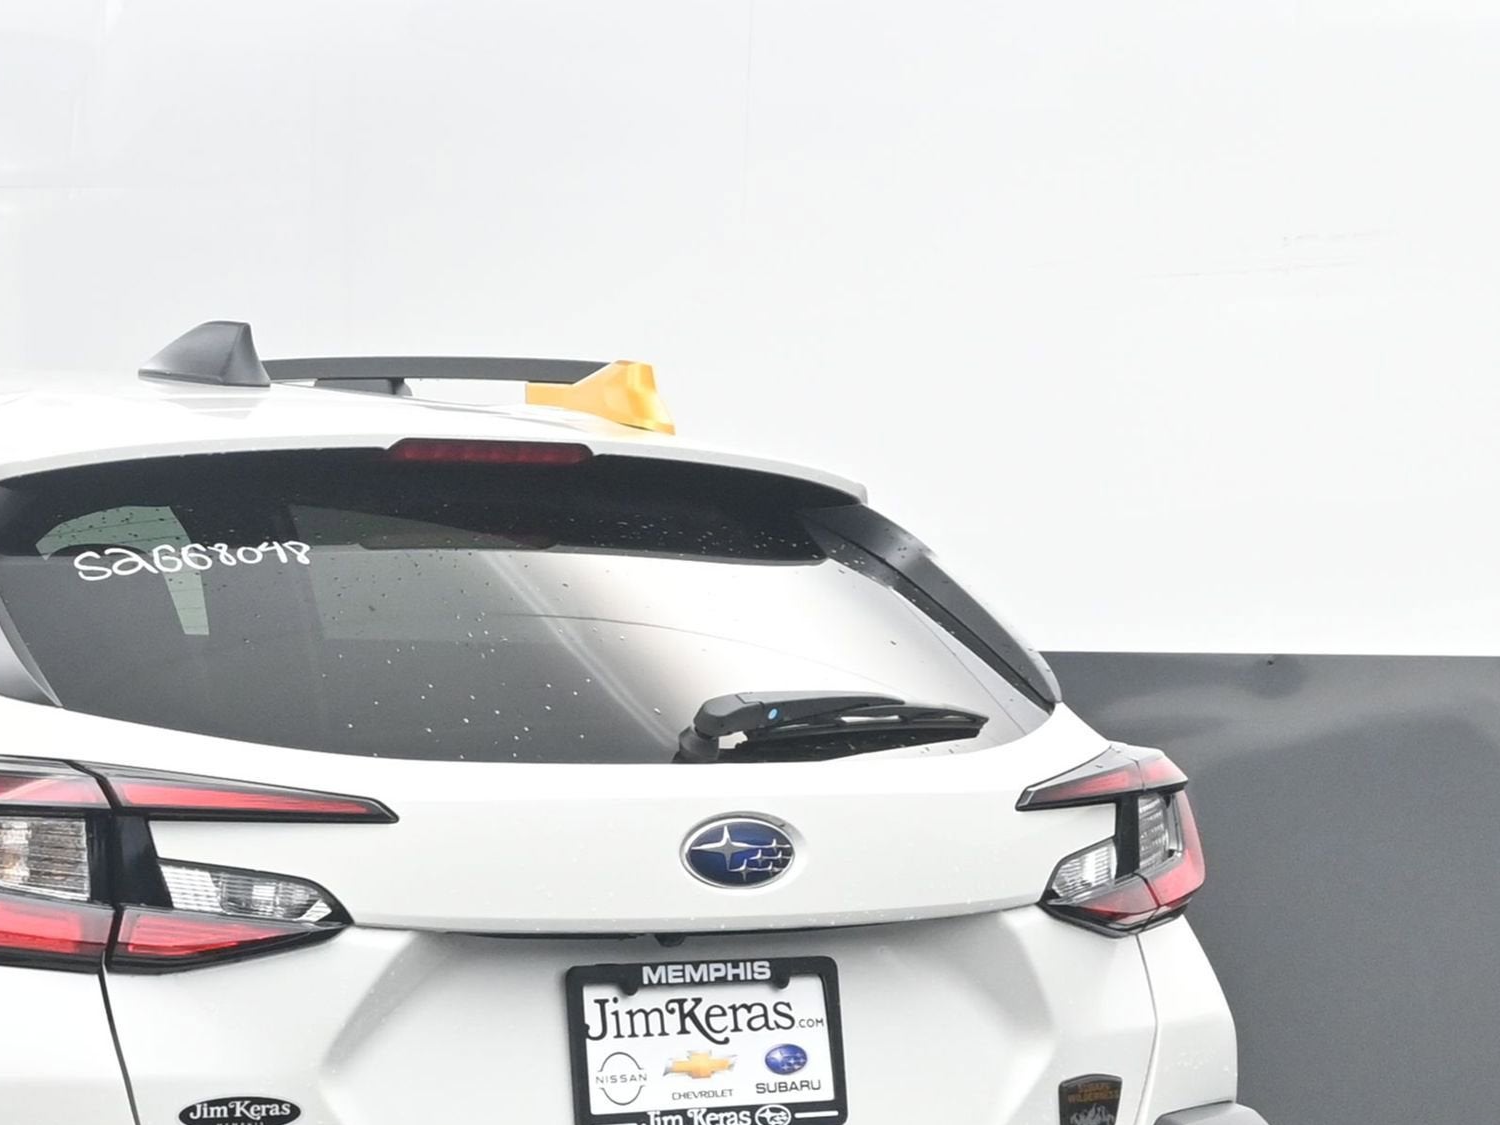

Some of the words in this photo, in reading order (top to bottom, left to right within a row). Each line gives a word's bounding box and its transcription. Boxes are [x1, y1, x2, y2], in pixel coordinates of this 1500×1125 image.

[642, 961, 771, 984] MEMPHIS
[595, 1073, 648, 1085] NISSAN
[755, 1080, 822, 1094] SUBARU
[671, 1088, 734, 1101] CHEVROLET
